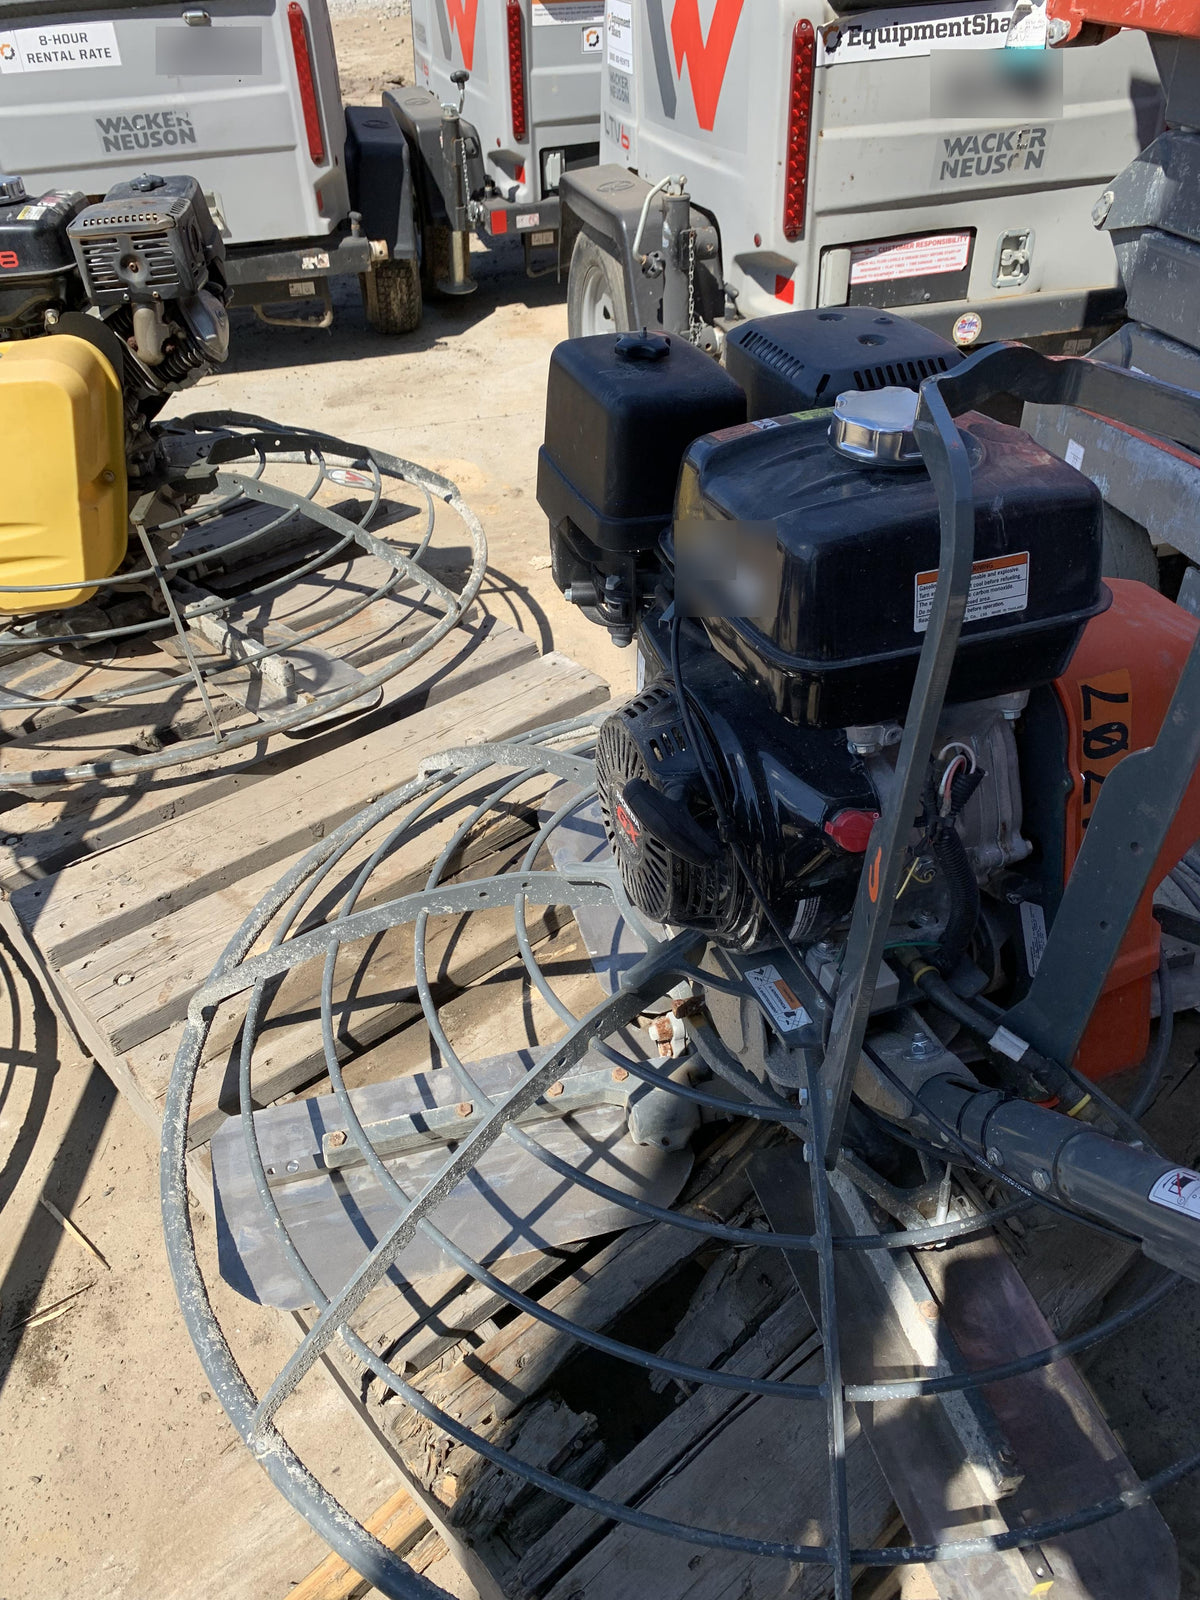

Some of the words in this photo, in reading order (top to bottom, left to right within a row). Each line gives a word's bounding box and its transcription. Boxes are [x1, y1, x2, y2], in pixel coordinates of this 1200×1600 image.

[39, 32, 88, 46] 8-HOUR
[847, 14, 1011, 49] EquipmentSha
[26, 50, 76, 64] RENTAL
[79, 47, 112, 60] RATE
[102, 127, 196, 152] NEUSON
[943, 128, 1047, 158] WACKER
[878, 241, 915, 252] CUSTOMER
[916, 235, 968, 248] RESPONSIBILITY
[973, 580, 983, 588] cool
[984, 578, 1000, 586] before
[973, 588, 990, 596] carbon
[967, 605, 981, 613] before
[617, 805, 640, 848] GX
